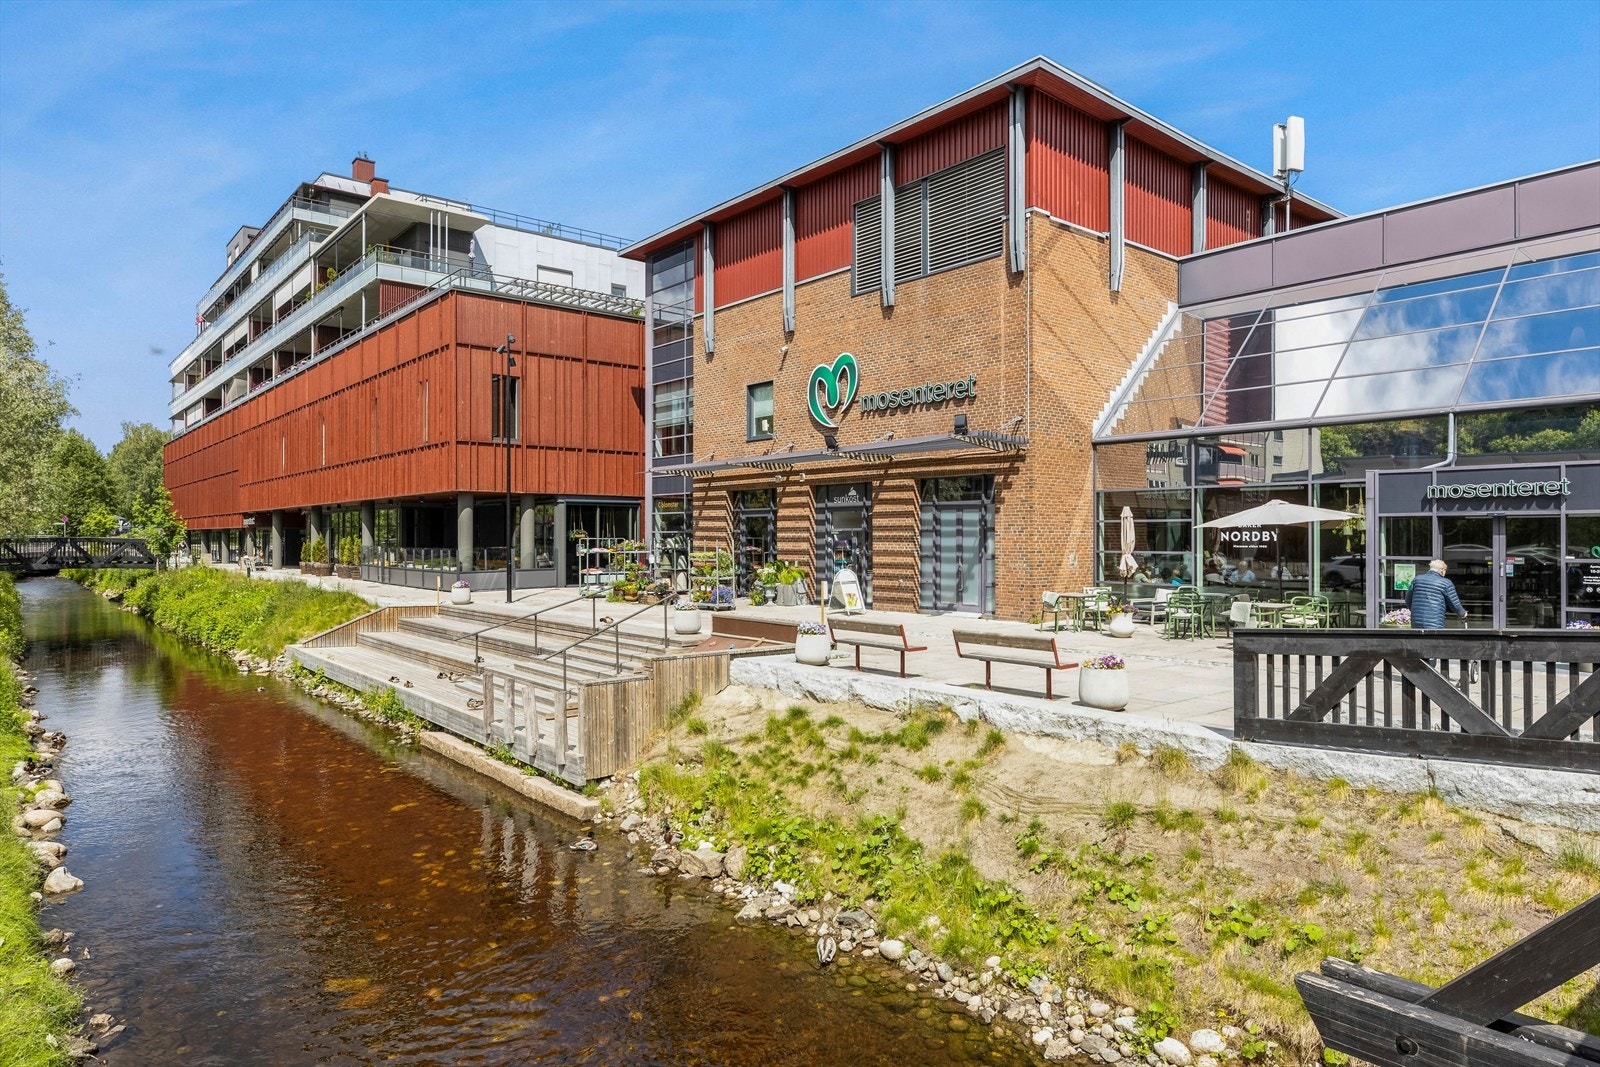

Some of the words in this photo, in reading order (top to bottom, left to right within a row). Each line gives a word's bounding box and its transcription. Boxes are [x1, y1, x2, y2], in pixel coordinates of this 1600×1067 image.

[861, 374, 976, 412] mosenteret
[1427, 478, 1571, 499] mosenteret
[833, 493, 860, 504] sunkost
[1220, 531, 1278, 541] NORDBY
